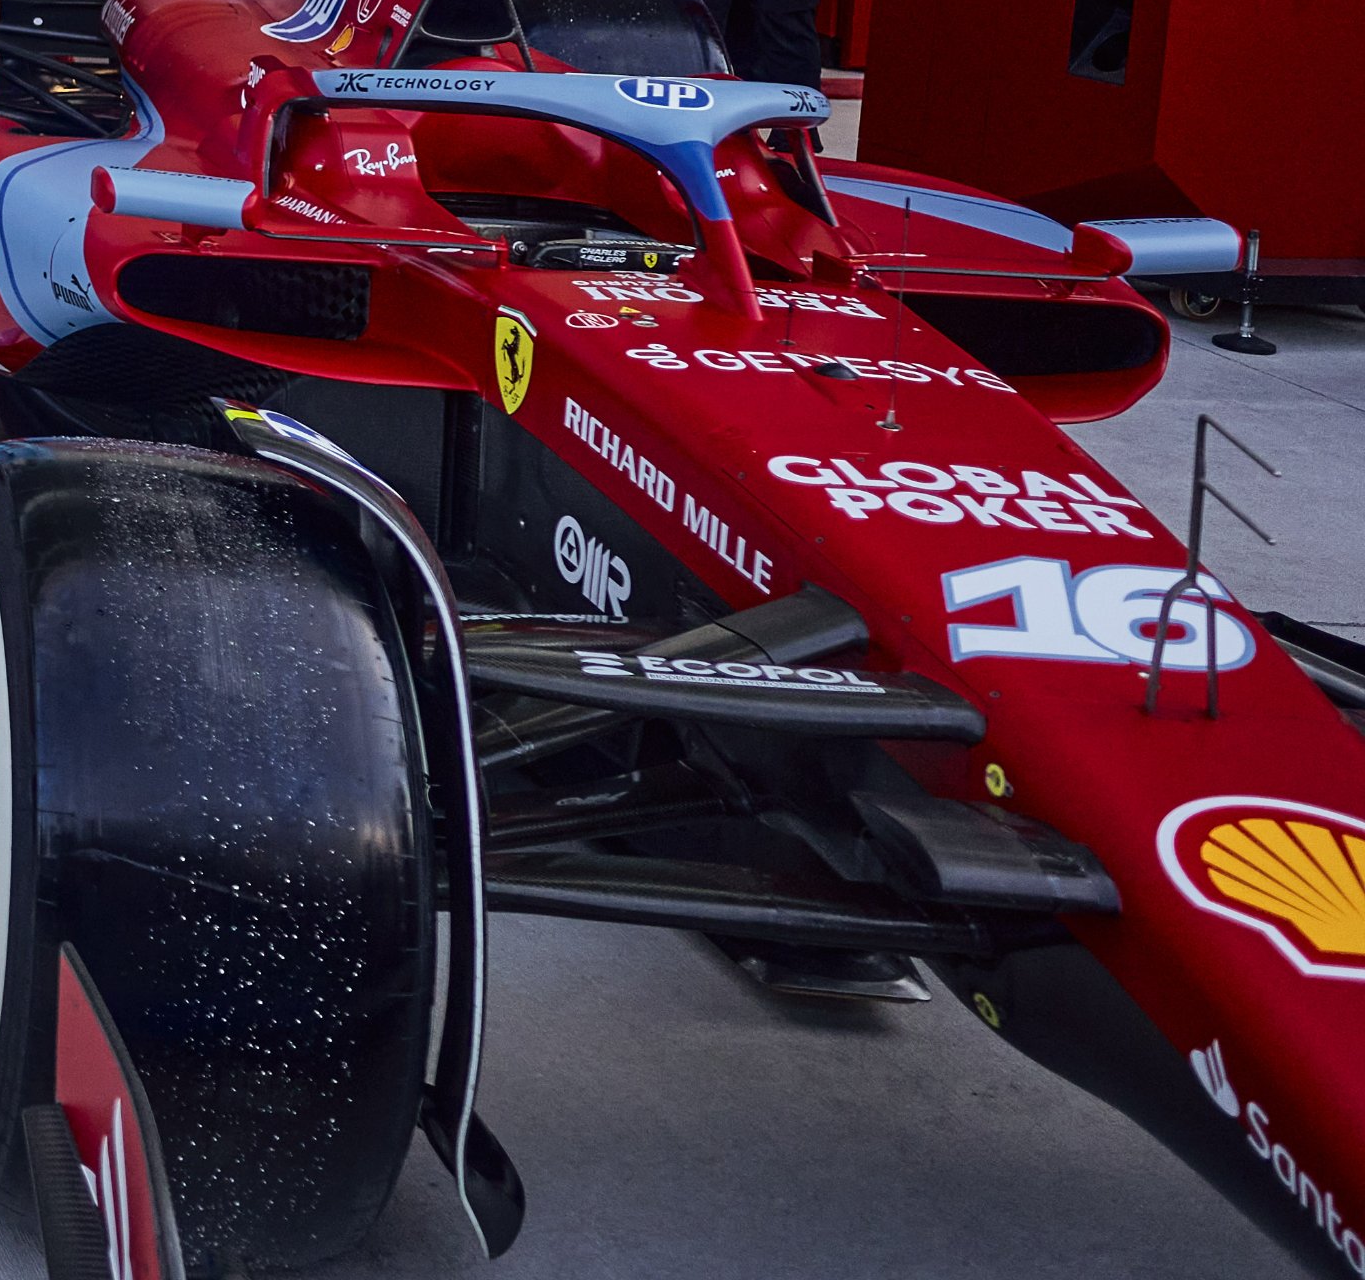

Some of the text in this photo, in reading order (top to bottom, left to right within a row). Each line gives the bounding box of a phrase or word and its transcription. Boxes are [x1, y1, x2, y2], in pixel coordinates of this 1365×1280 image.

[376, 75, 496, 93] TECHNOLOGY
[634, 76, 698, 110] hp
[579, 247, 627, 256] CHARLES
[51, 281, 92, 312] PUMA
[693, 349, 1019, 394] GENESYS
[563, 396, 774, 595] RICHARD MILLE
[767, 455, 1144, 509] GLOBAL
[826, 487, 1155, 539] POKER
[940, 555, 1257, 673] 16
[636, 654, 880, 687] ECOPOL
